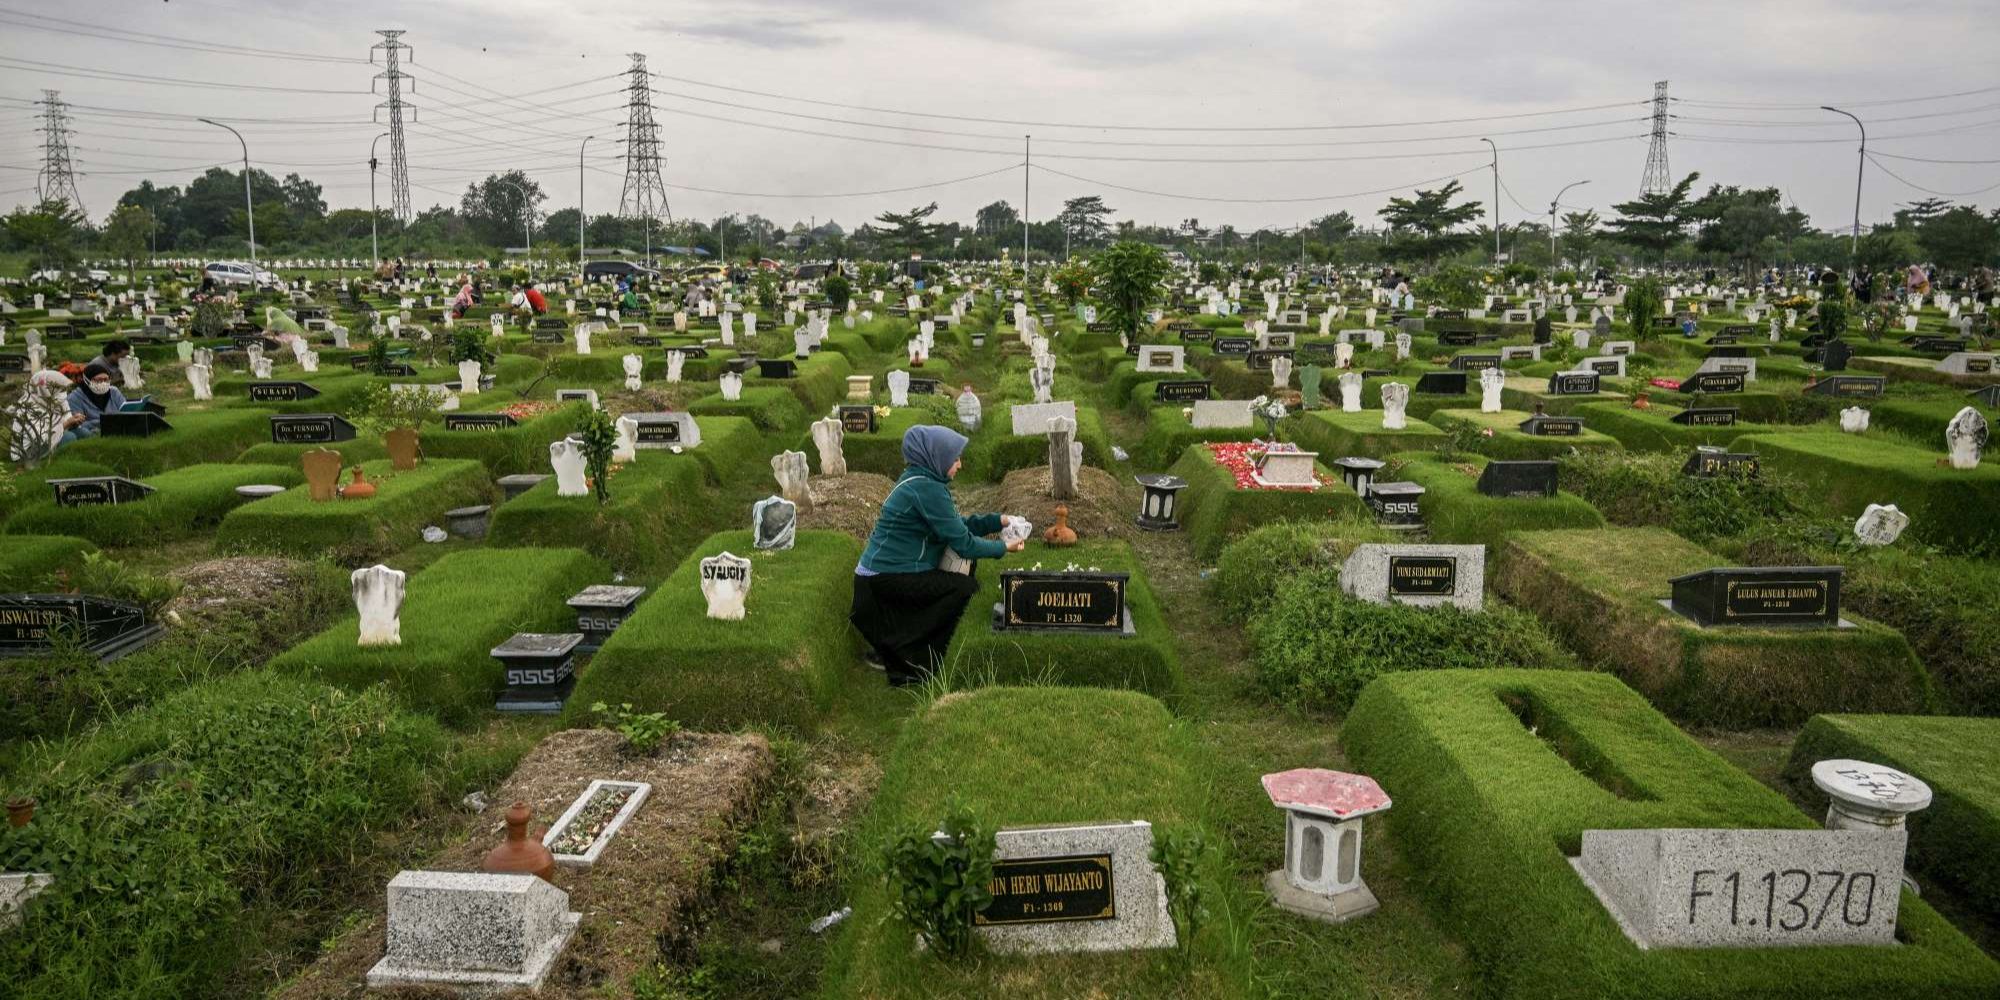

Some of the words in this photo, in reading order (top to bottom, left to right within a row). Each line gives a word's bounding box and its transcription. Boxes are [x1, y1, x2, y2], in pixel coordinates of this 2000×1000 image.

[1037, 591, 1092, 608] JOELIATI
[1737, 589, 1759, 599] LULUS
[1760, 588, 1786, 599] JANUAR
[1787, 587, 1818, 599] ERIANTO
[0, 609, 40, 625] ISWATI
[1010, 873, 1041, 896] HERU
[1044, 869, 1103, 894] WIJAYANTO
[1689, 868, 1877, 932] F1.1370
